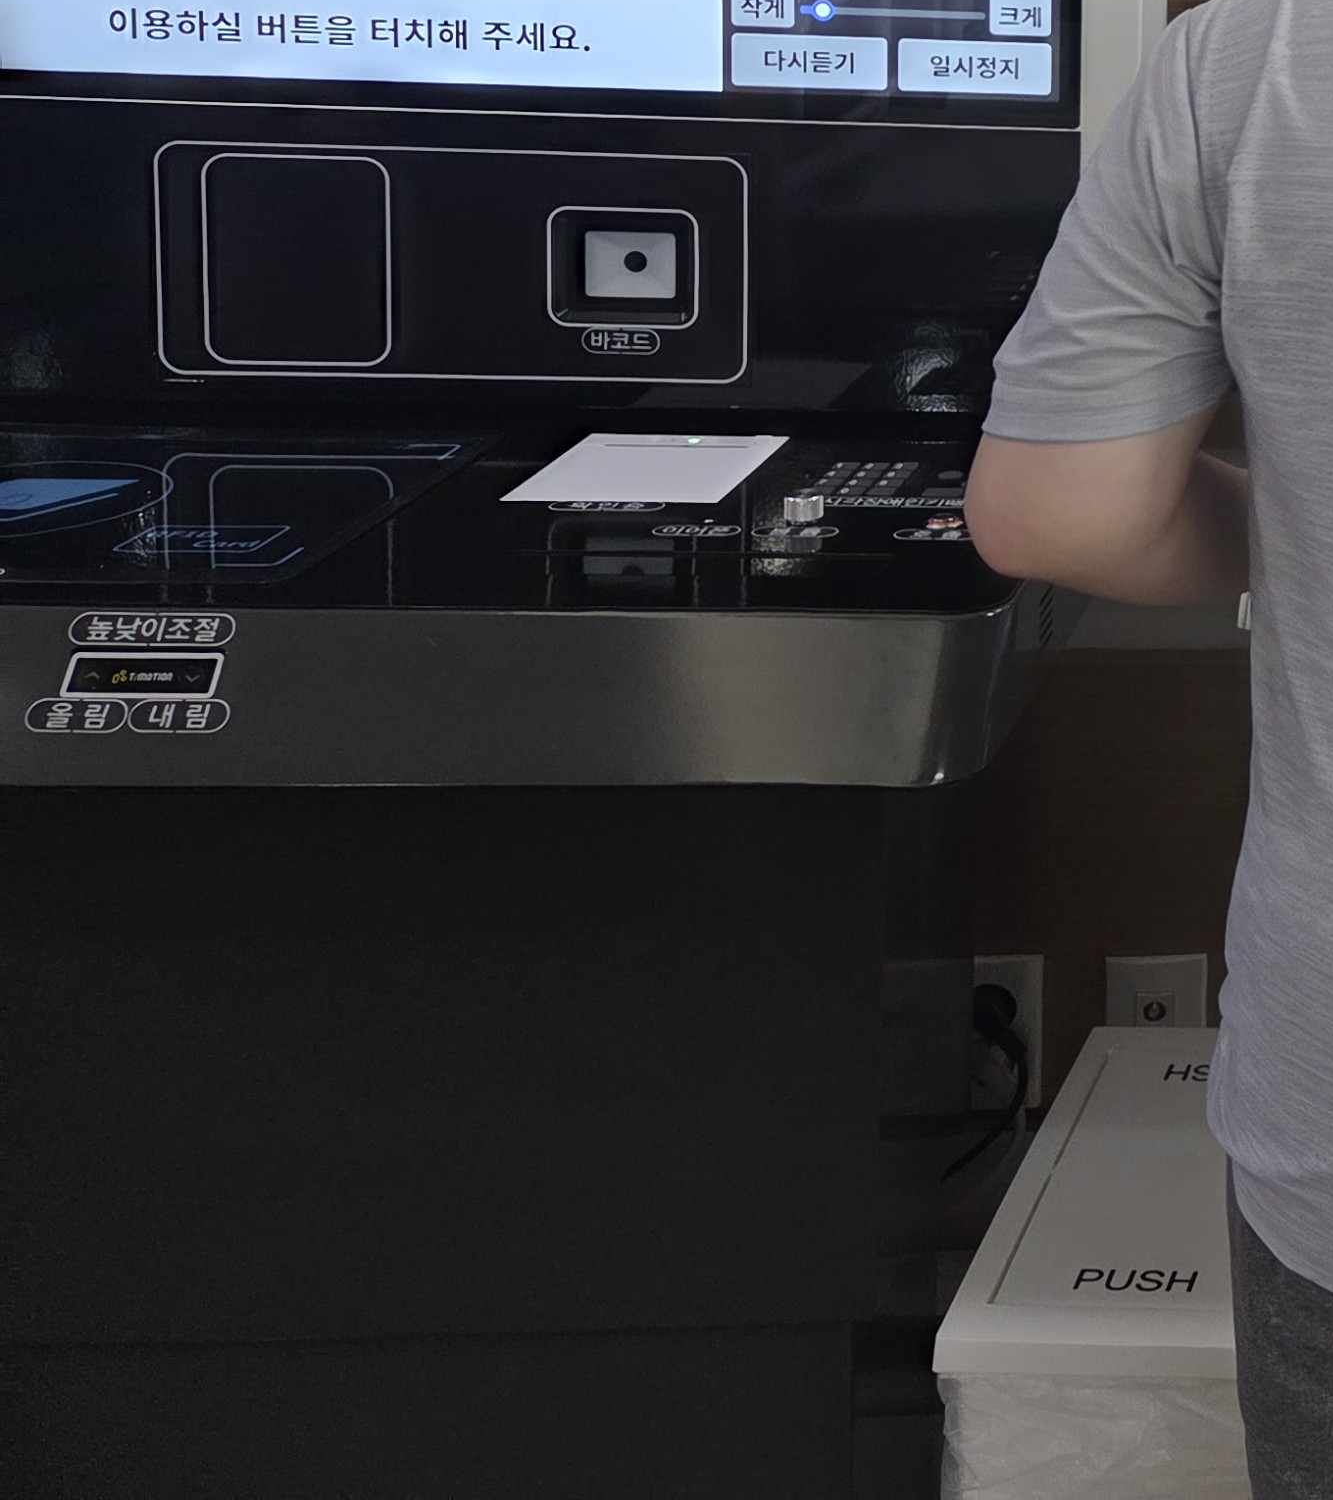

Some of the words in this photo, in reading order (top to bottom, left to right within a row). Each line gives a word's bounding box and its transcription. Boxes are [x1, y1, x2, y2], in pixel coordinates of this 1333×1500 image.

[109, 7, 242, 42] 이용하실
[257, 14, 356, 45] 버튼을
[371, 19, 469, 51] 터치해
[481, 21, 591, 53] 주세요.
[999, 7, 1042, 29] 크게
[764, 50, 855, 75] 다시듣기
[930, 55, 1019, 80] 일시정지
[590, 329, 651, 353] 바코드
[192, 539, 261, 548] Card
[87, 617, 220, 641] 높낮이조절
[1073, 1269, 1199, 1292] PUSH
